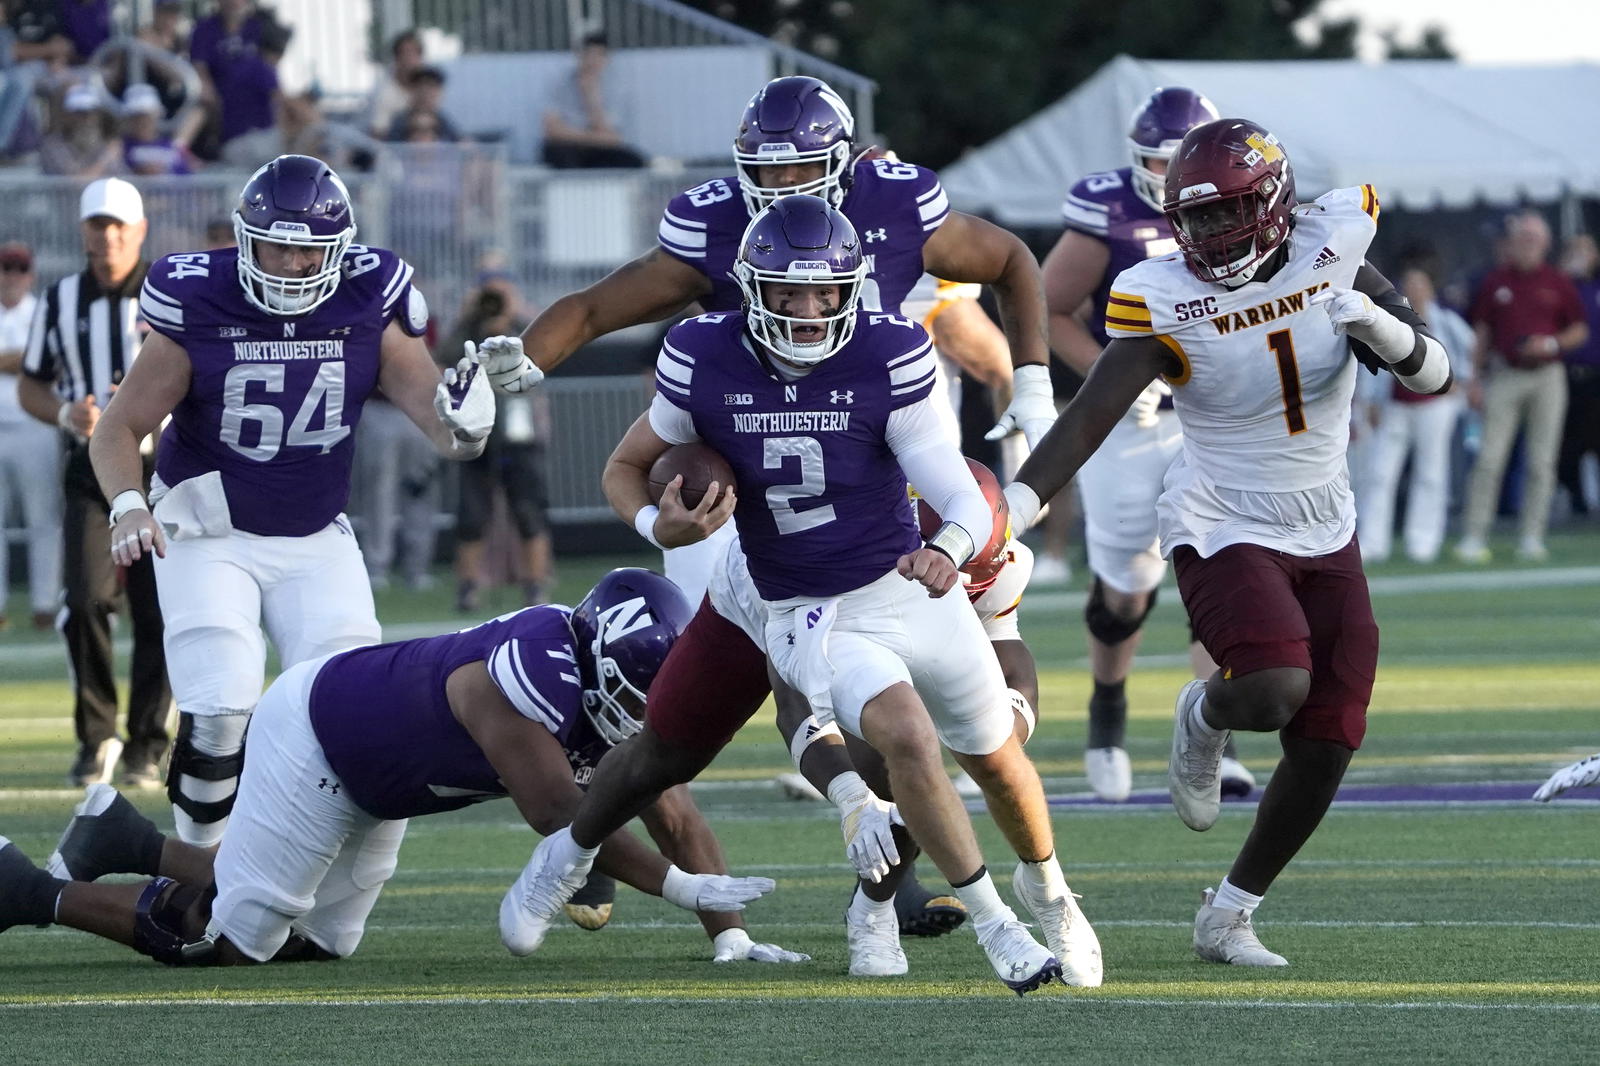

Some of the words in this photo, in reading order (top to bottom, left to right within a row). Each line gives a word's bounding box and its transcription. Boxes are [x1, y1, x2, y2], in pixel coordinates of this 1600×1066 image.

[684, 178, 733, 207] 63
[168, 253, 210, 280] 64
[795, 262, 827, 270] WILDCATS
[1312, 255, 1341, 270] adidas
[1174, 296, 1219, 322] SBC
[283, 323, 296, 337] N
[233, 340, 344, 360] NORTHWESTERN
[785, 385, 797, 402] N
[1266, 328, 1308, 436] 1
[219, 361, 351, 462] 64
[732, 411, 850, 432] NORTHWESTERN
[763, 436, 837, 535] 2
[597, 596, 653, 645] N
